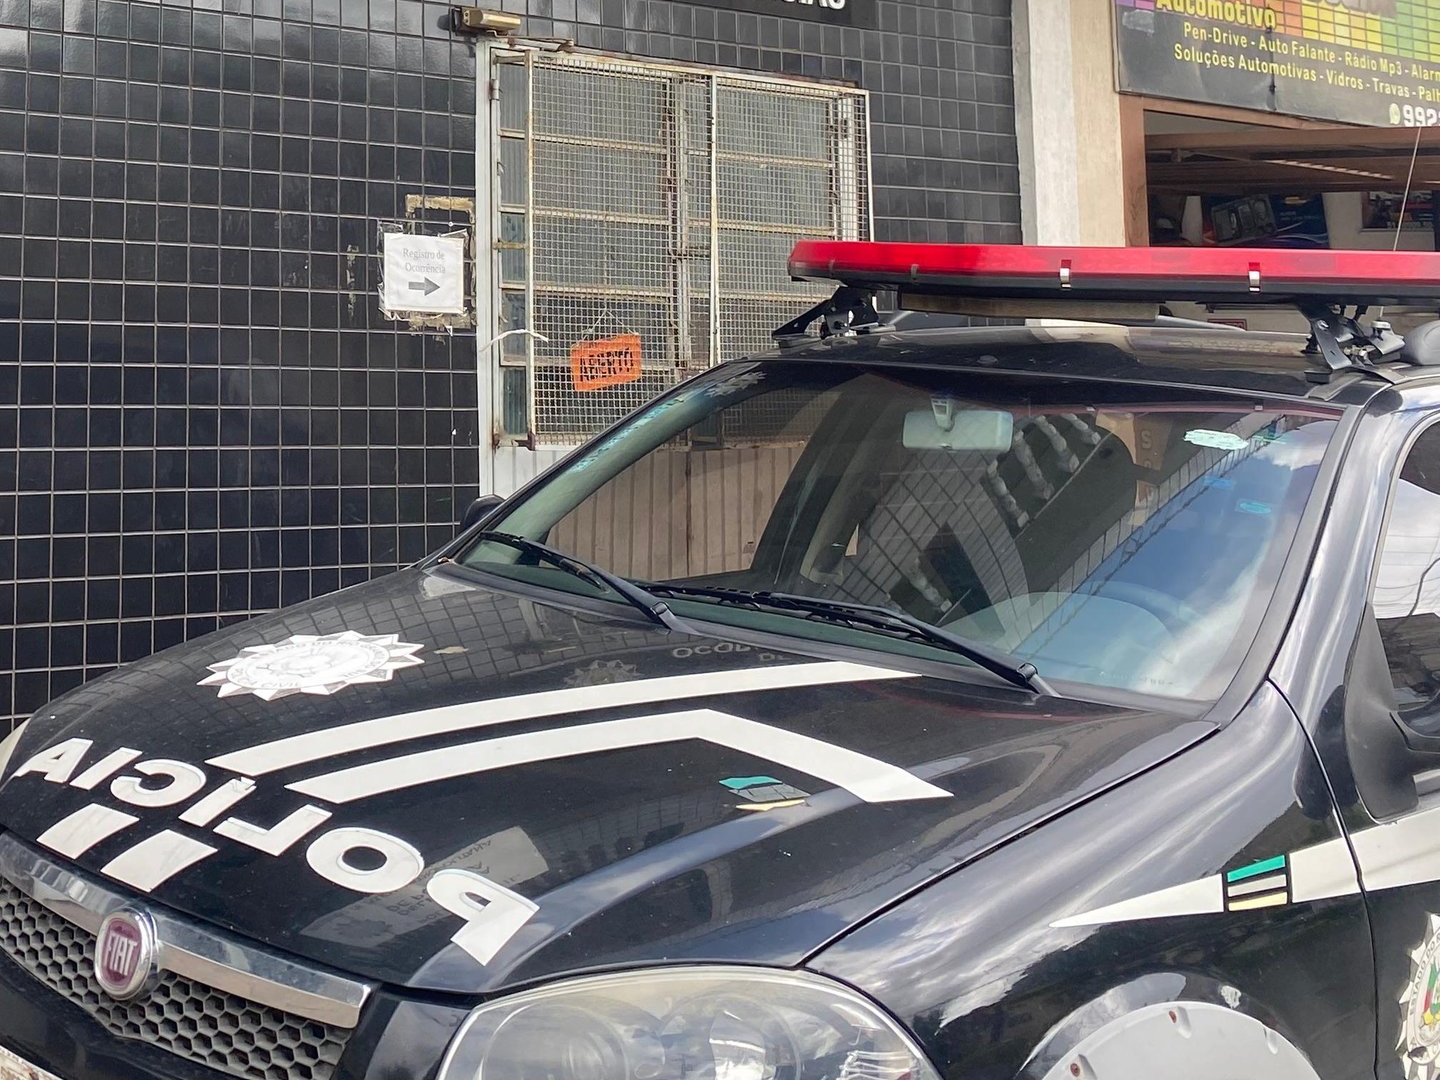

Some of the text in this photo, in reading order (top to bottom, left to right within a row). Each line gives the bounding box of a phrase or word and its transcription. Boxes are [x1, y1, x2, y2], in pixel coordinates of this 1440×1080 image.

[1174, 43, 1236, 69] Soluções
[1238, 54, 1317, 82] Automotivas
[1326, 69, 1364, 90] Vidros
[1372, 77, 1411, 98] Travas
[1183, 21, 1248, 48] Pen-Drive
[1259, 35, 1289, 55] Auto
[1291, 40, 1336, 64] Falante
[1345, 51, 1377, 71] Rádio
[1379, 57, 1403, 77] Mp3
[402, 248, 446, 260] Registro de
[103, 929, 138, 977] FIAT
